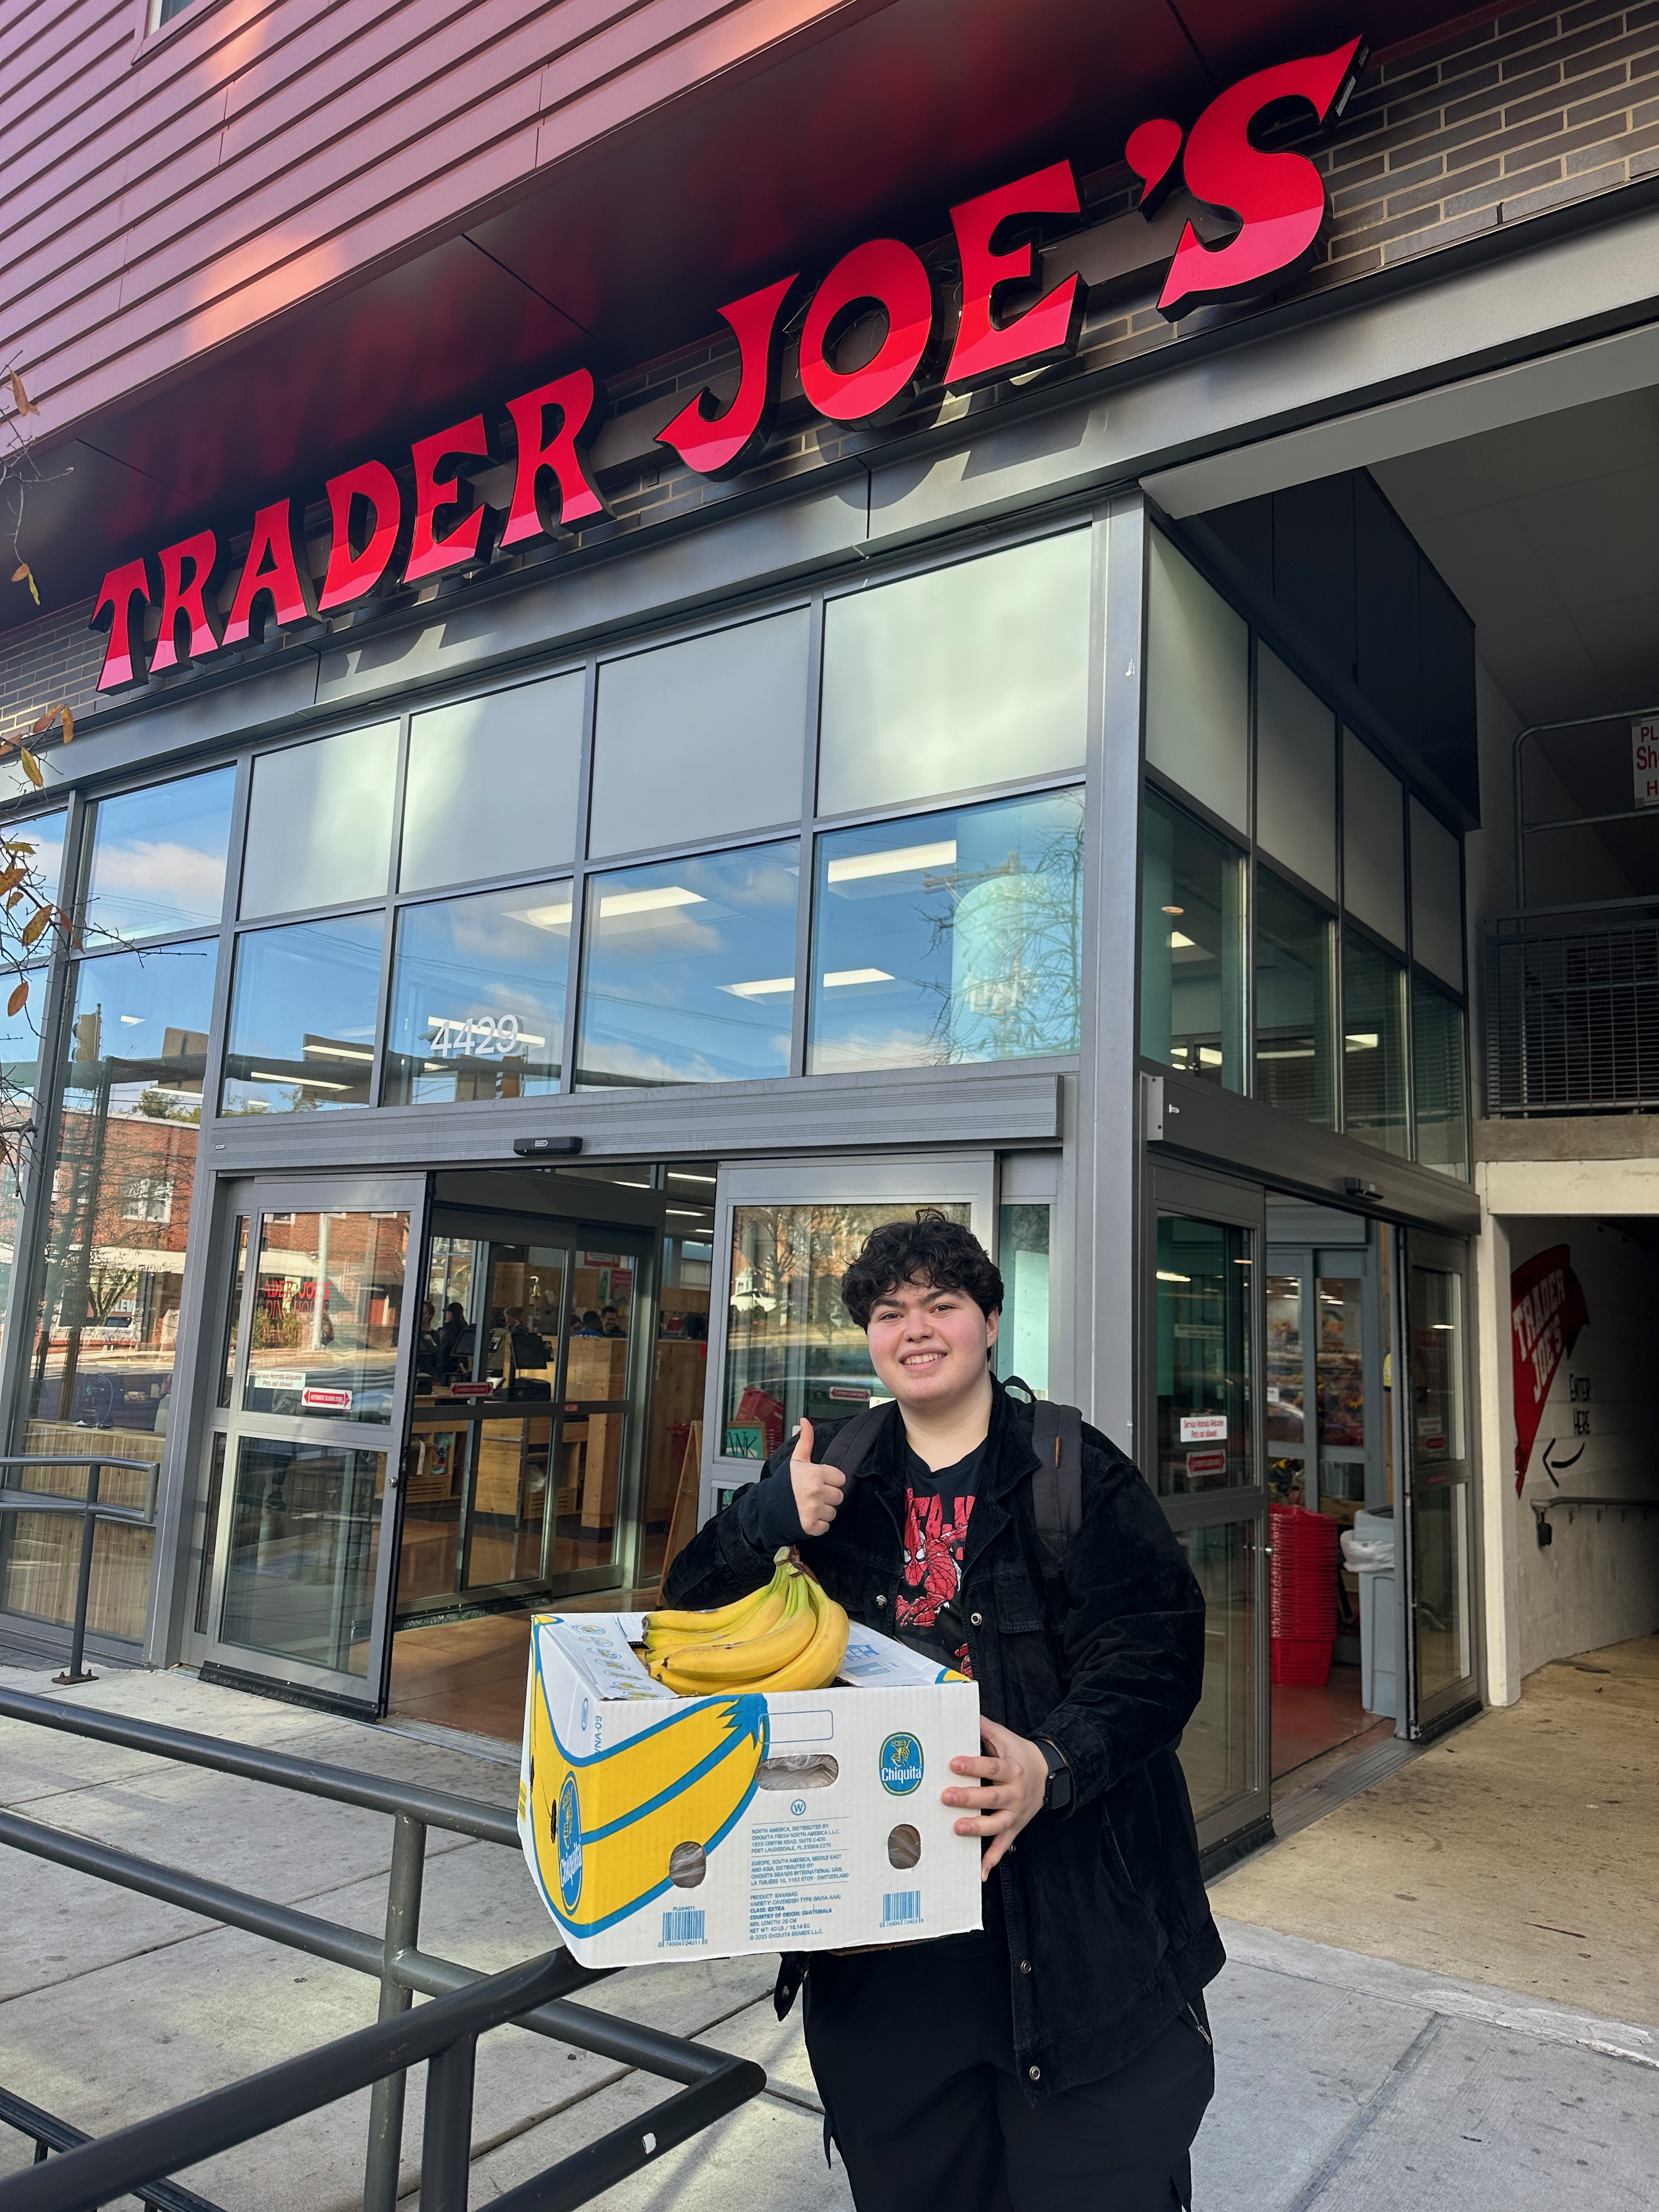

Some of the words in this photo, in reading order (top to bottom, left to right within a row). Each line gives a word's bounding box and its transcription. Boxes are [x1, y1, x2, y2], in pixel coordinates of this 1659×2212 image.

[90, 366, 609, 694] TRADER
[654, 34, 1364, 476] JOE'S
[1641, 725, 1659, 742] PL
[1637, 745, 1659, 770] Sh
[430, 1014, 518, 1057] 4429
[1513, 1268, 1566, 1362] TRADER
[1532, 1313, 1562, 1404] JOE'S
[882, 1766, 922, 1784] Chiquita
[560, 1841, 582, 1887] Chiquita
